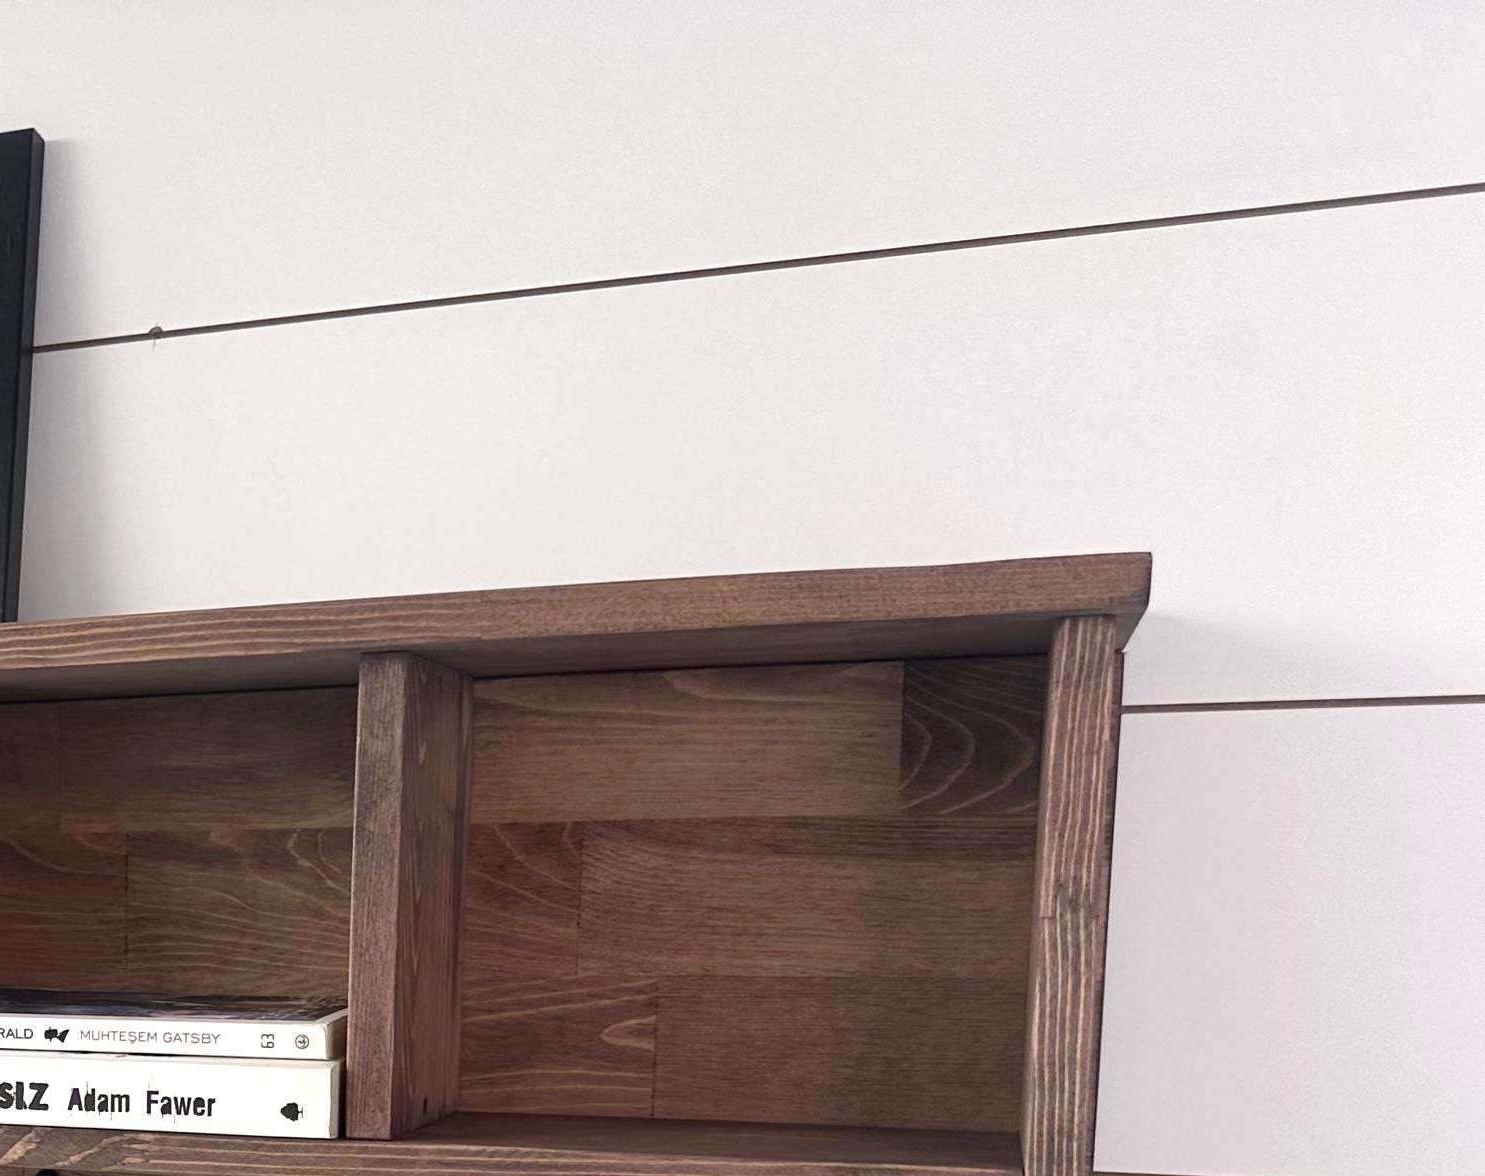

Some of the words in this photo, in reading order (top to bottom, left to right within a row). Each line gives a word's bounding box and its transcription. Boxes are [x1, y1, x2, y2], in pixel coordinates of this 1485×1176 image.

[80, 1029, 158, 1044] MUHTEŞEM
[162, 1031, 221, 1046] GATSBY
[67, 1086, 131, 1114] Adam
[146, 1089, 216, 1117] Fawer
